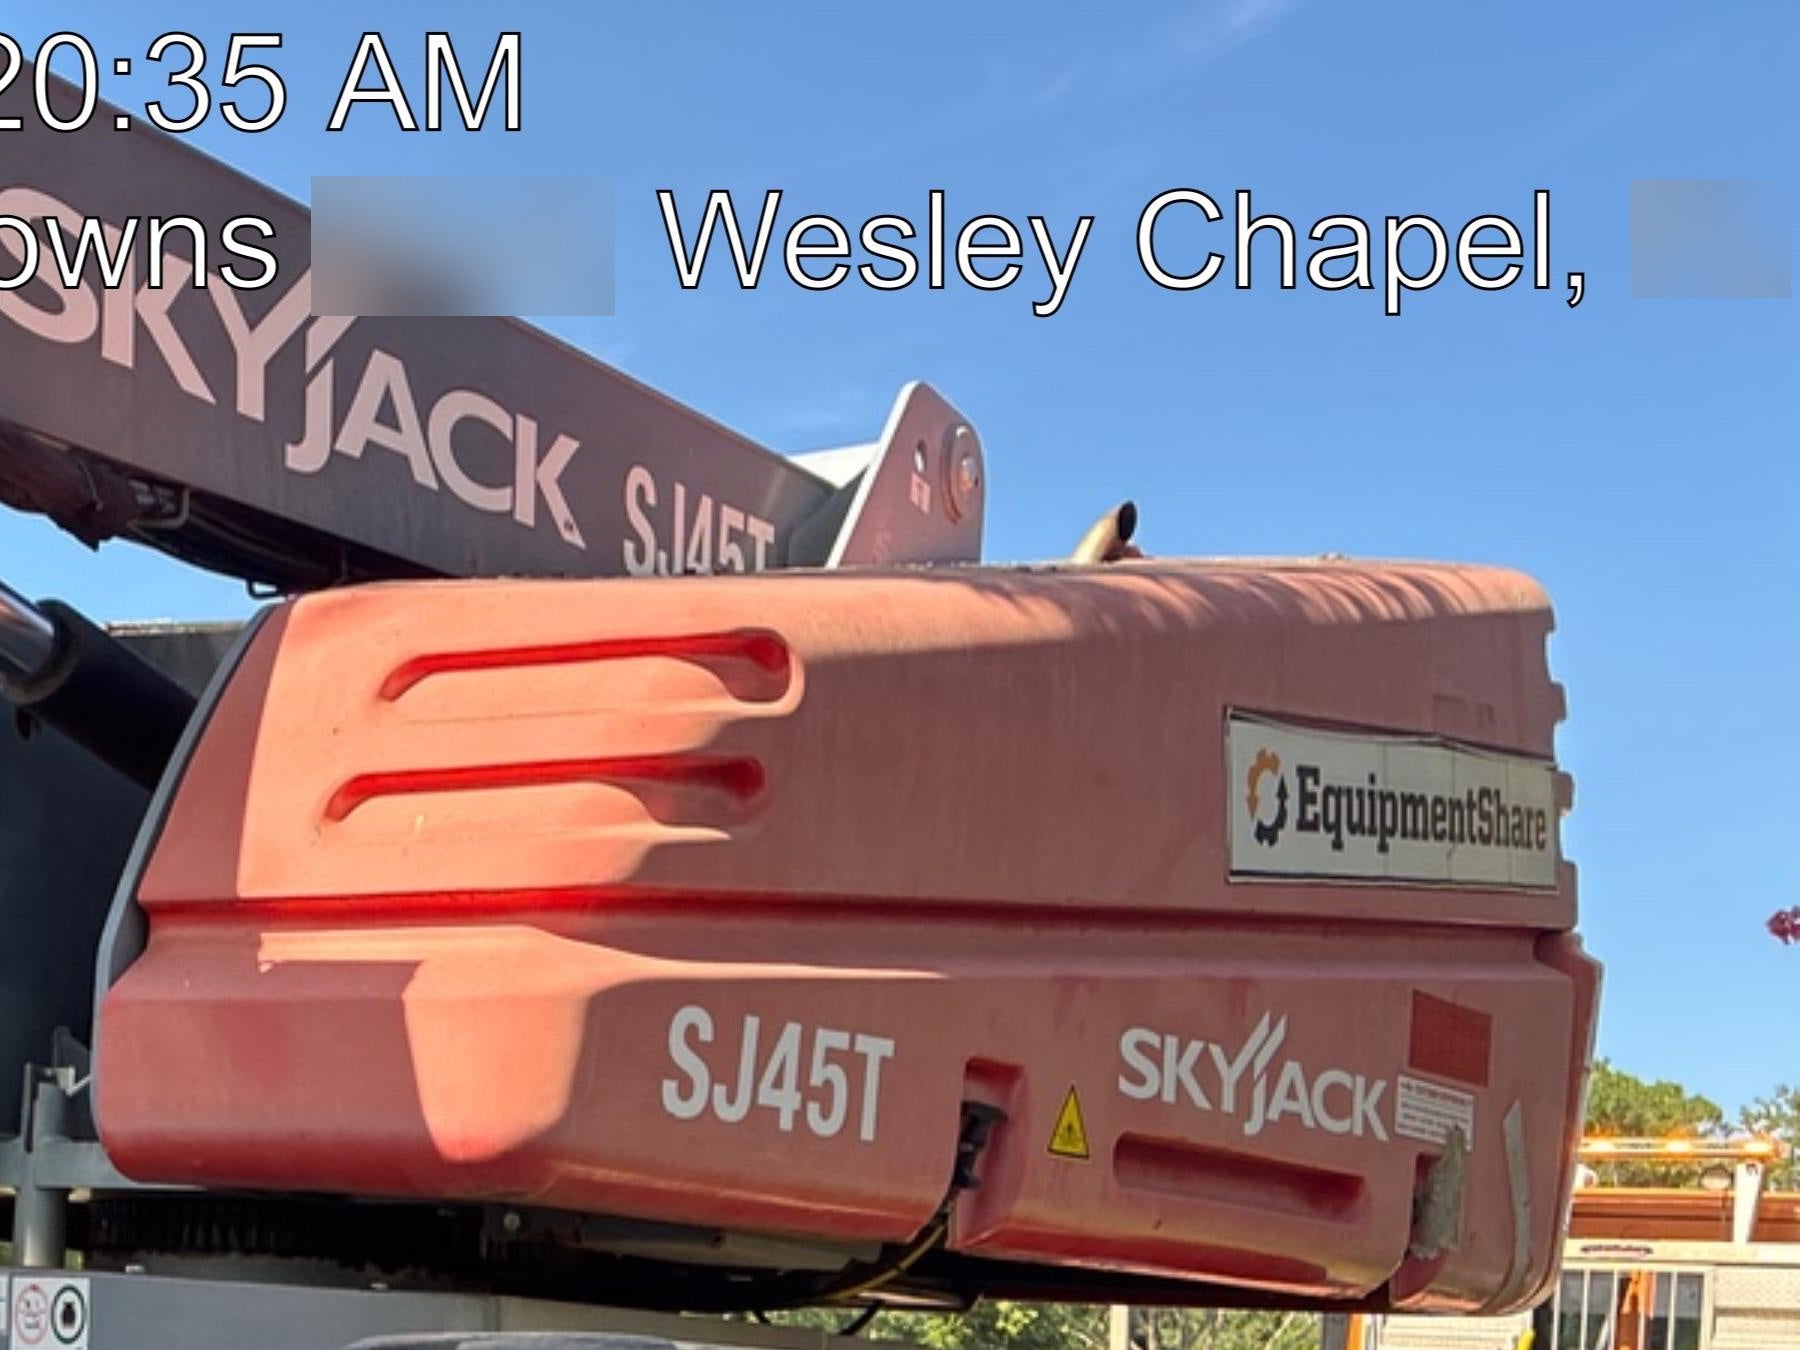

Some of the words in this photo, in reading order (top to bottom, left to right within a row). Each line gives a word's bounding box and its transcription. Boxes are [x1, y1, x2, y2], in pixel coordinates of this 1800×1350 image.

[1296, 765, 1547, 853] EquipmentShare
[661, 1004, 896, 1142] SJ45T
[1117, 1009, 1390, 1143] SKYJACK
